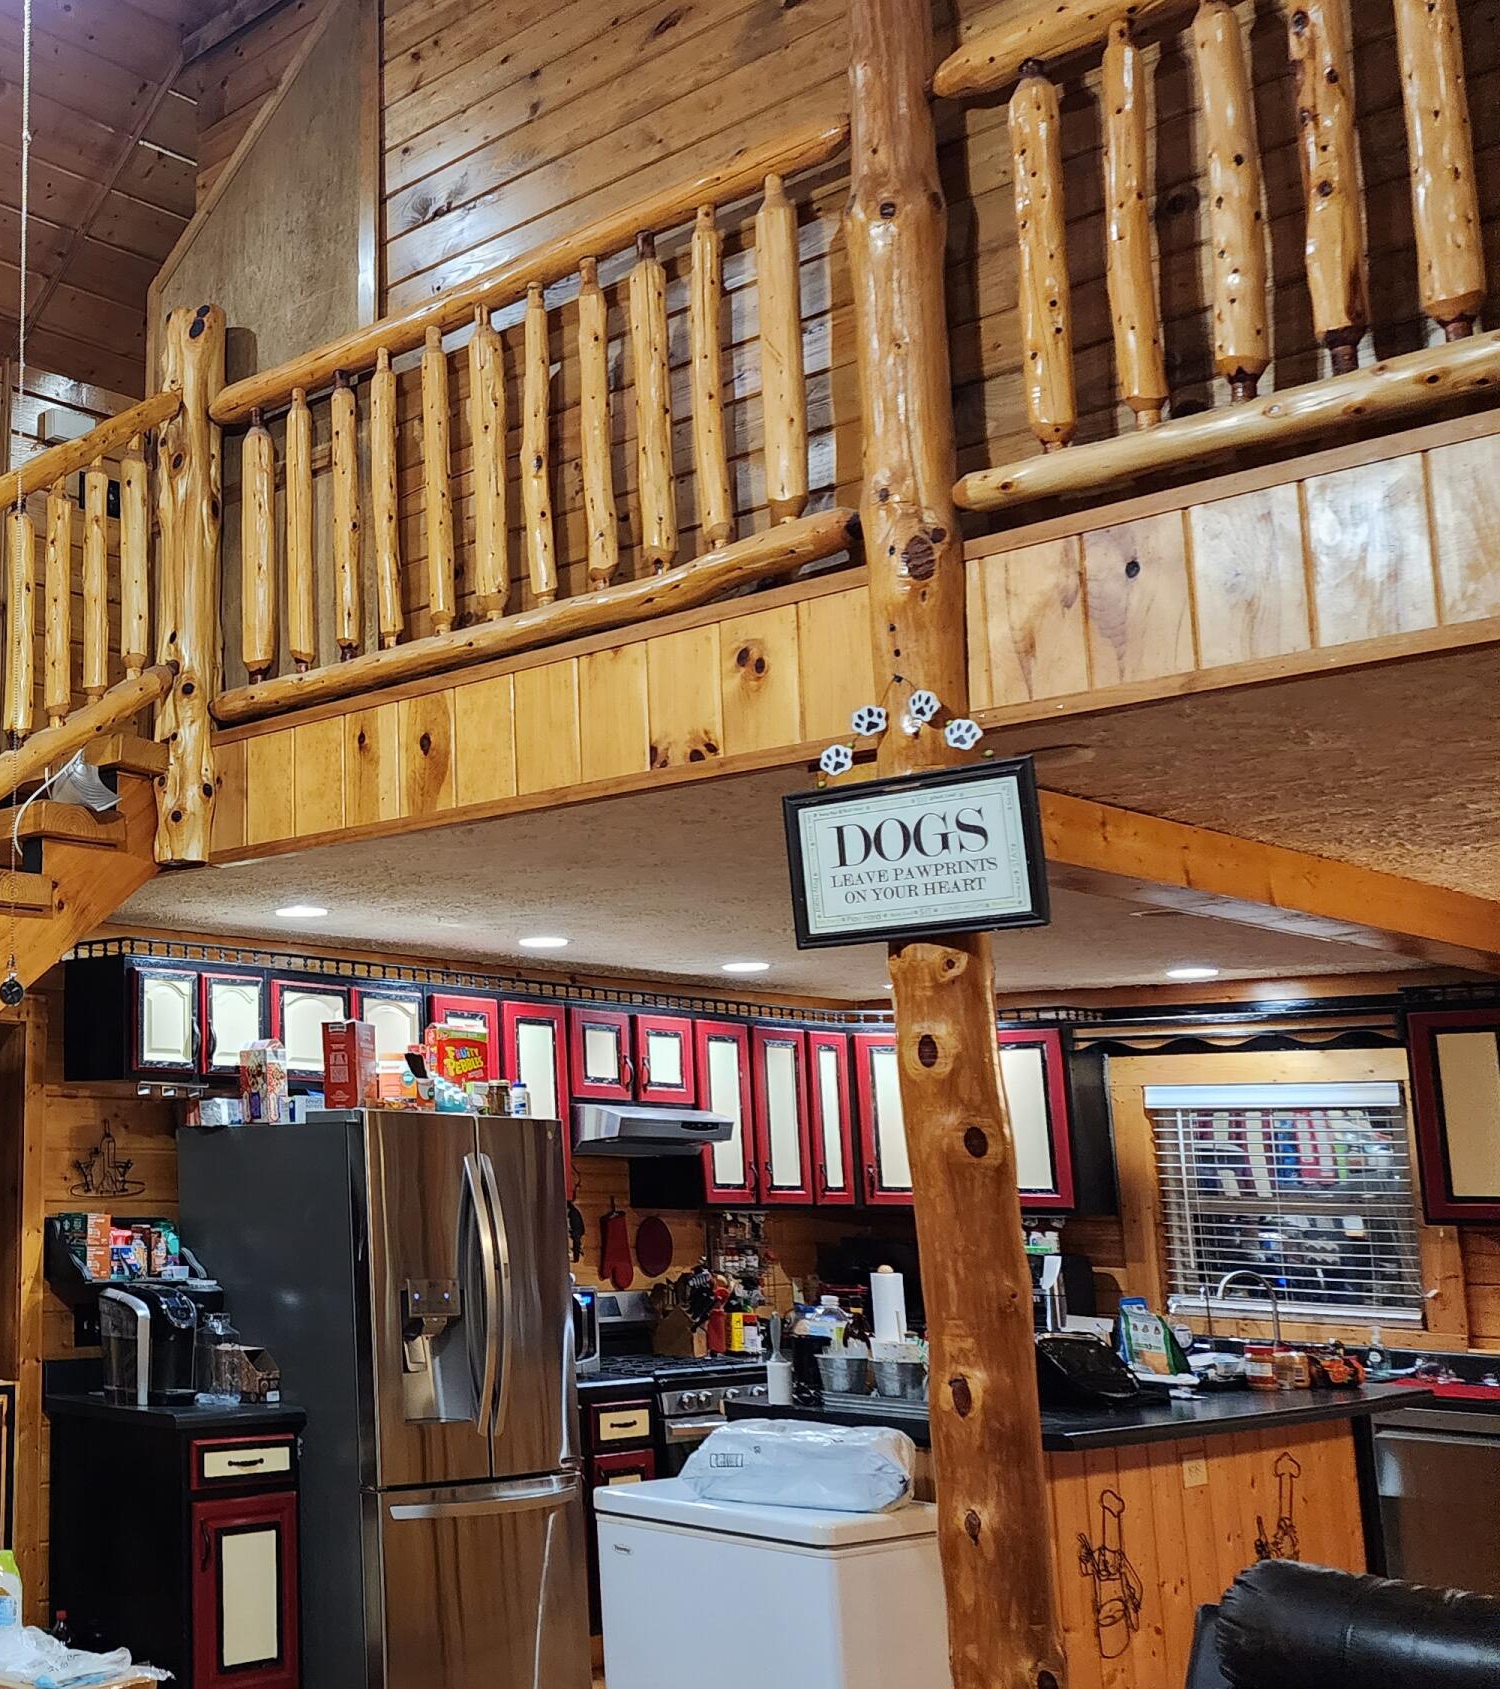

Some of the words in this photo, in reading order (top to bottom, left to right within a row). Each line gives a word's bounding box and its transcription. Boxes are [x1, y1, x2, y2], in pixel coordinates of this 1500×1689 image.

[828, 807, 989, 869] DOGS
[831, 869, 889, 888] LEAVE
[894, 857, 998, 881] PAWPRINTS
[844, 888, 868, 904] ON
[870, 882, 919, 902] YOUR
[924, 877, 987, 896] HEART
[443, 1056, 484, 1077] PEBBLES
[445, 1046, 479, 1060] FRUITY
